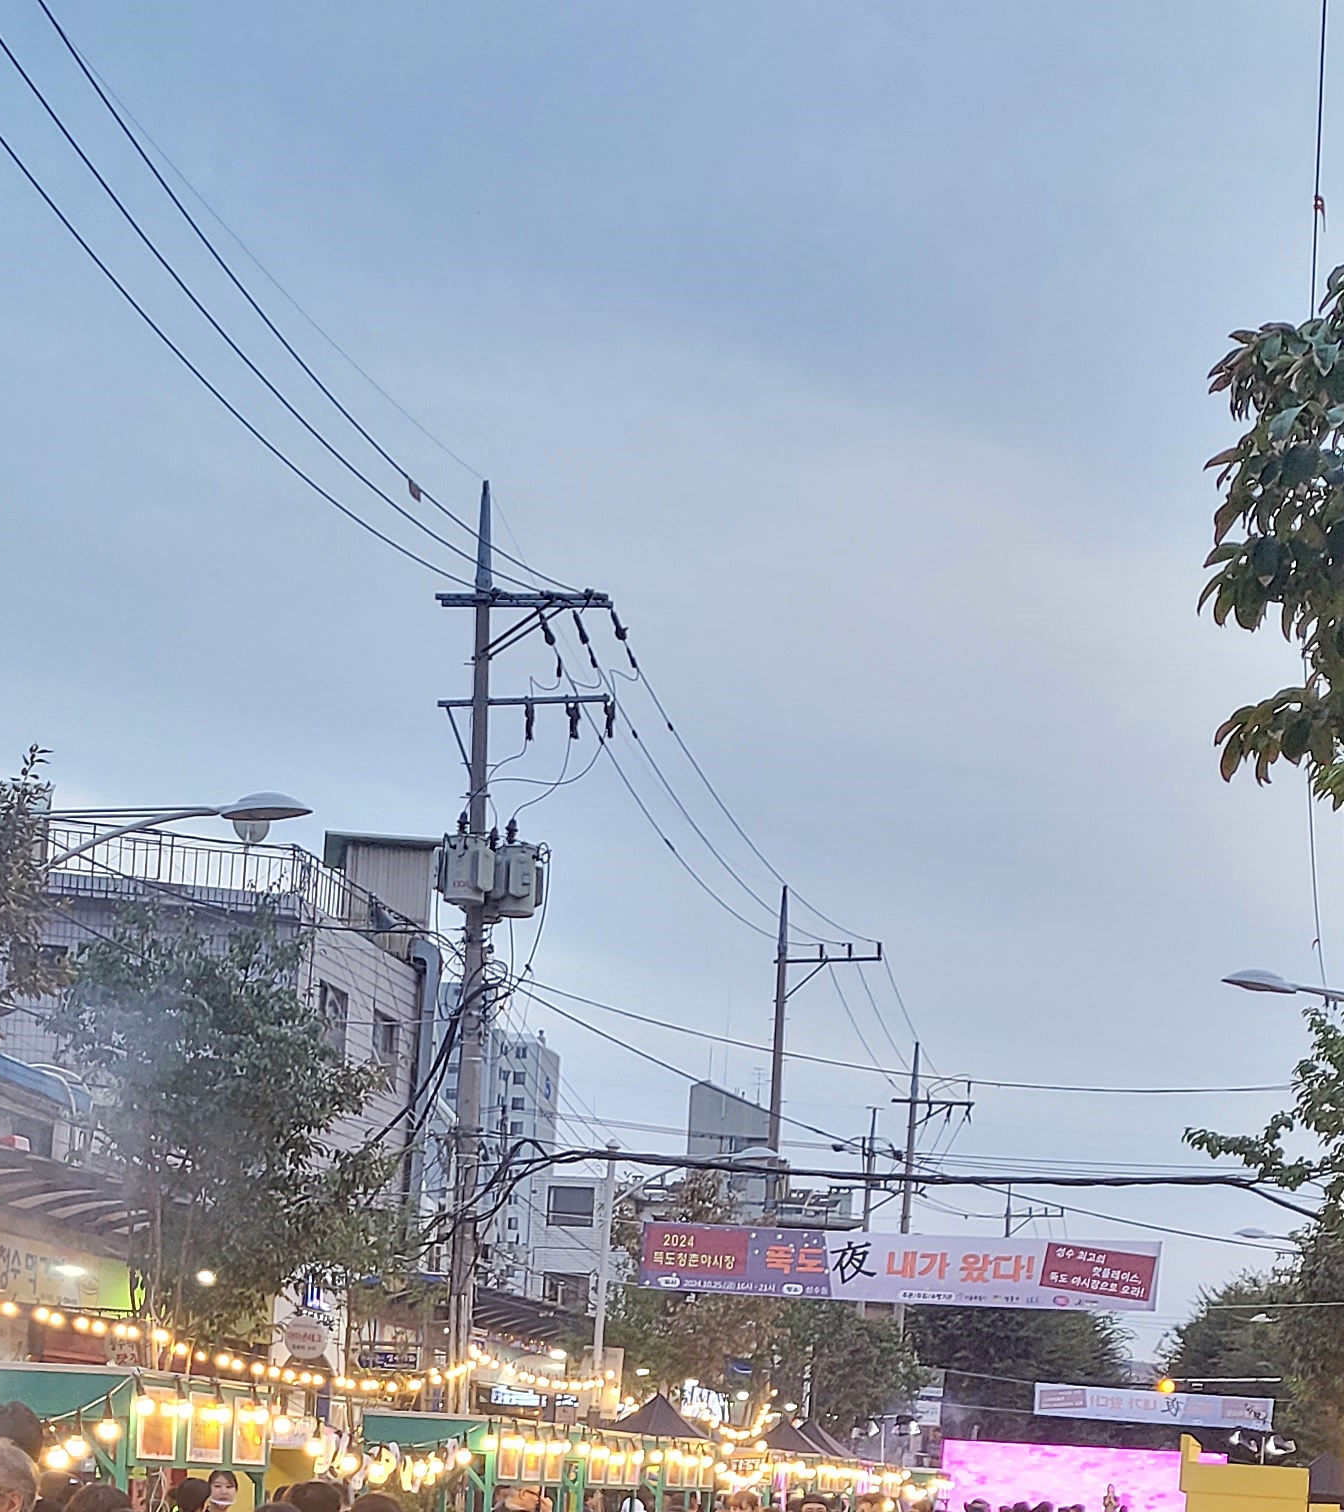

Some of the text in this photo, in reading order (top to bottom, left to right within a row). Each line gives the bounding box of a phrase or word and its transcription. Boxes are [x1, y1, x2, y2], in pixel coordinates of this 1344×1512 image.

[663, 1233, 695, 1248] 2024
[829, 1240, 877, 1285] 夜
[886, 1250, 951, 1279] 내가
[959, 1253, 1036, 1283] 왔다!
[1056, 1246, 1107, 1265] 성수 최고의
[1120, 1285, 1145, 1298] 오라!
